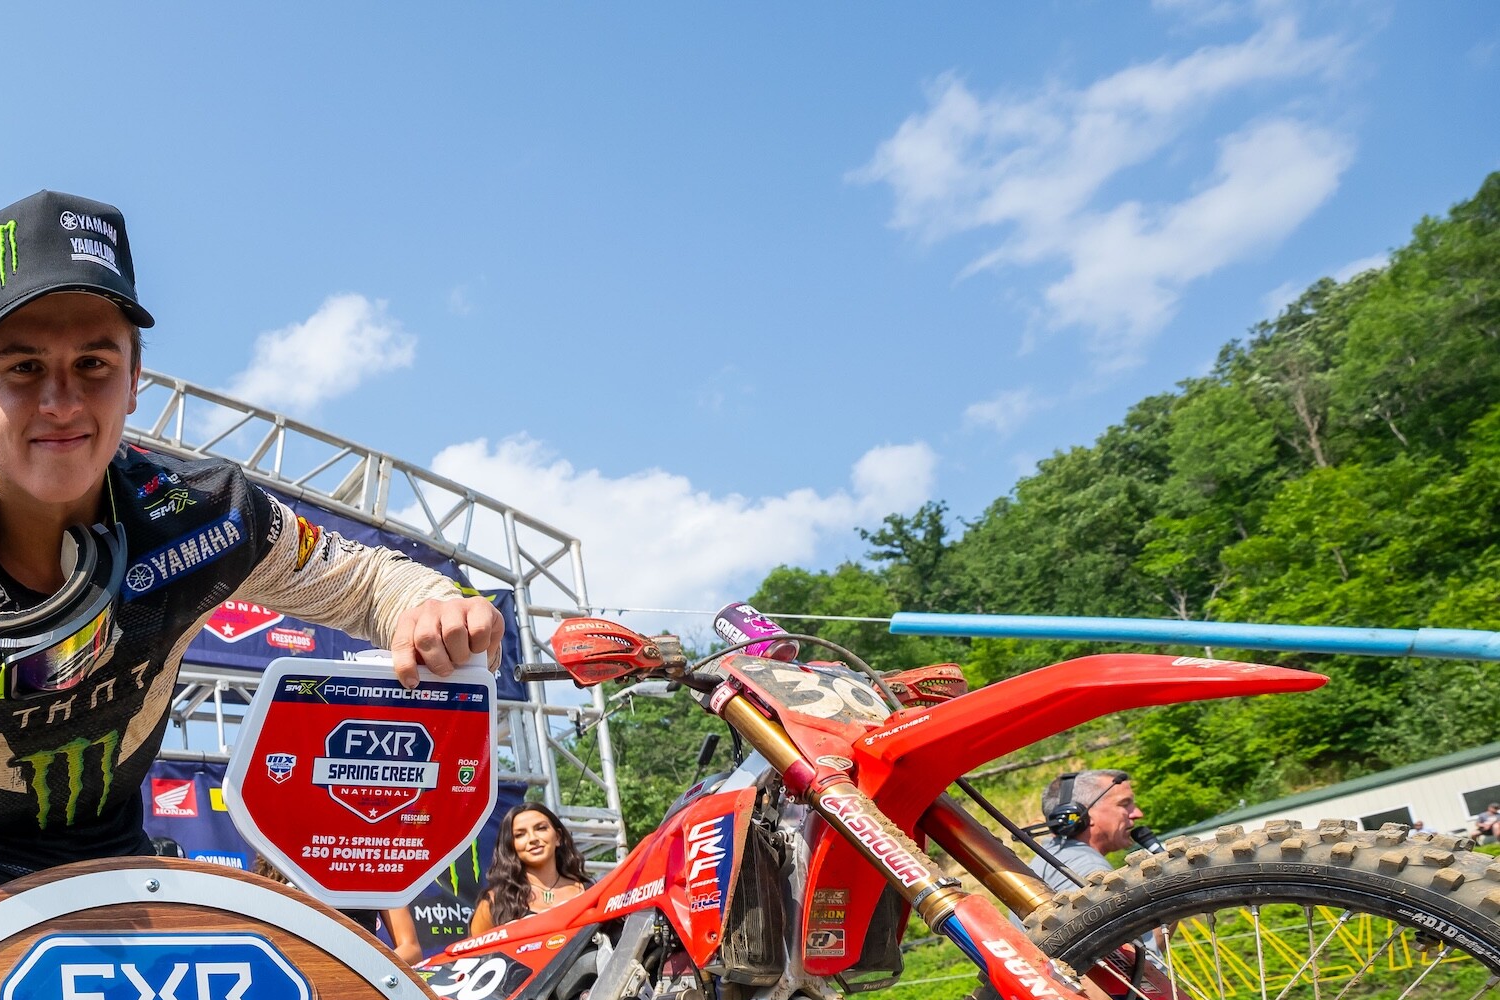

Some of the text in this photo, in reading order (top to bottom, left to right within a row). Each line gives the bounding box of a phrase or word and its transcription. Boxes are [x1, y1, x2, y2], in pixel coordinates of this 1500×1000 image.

[76, 215, 118, 246] YAMAHA
[150, 520, 242, 580] YAMAHA
[565, 621, 611, 632] HONDA
[271, 632, 311, 647] FRESCADOS
[772, 669, 891, 722] 30
[876, 714, 931, 739] TRUETIMBER
[345, 729, 417, 757] FXR
[328, 764, 425, 782] SPRING CREEK
[461, 771, 470, 782] 2
[340, 788, 410, 797] NATIONAL
[156, 807, 195, 816] HONDA
[400, 814, 430, 823] FRESCADOS
[312, 835, 424, 847] RND 7: SPRING CREEK
[688, 816, 727, 882] CRF
[844, 812, 929, 886] SHOWA
[302, 846, 430, 861] 250 POINTS LEADER
[329, 862, 404, 874] JULY 12, 2025
[452, 928, 509, 953] HONDA
